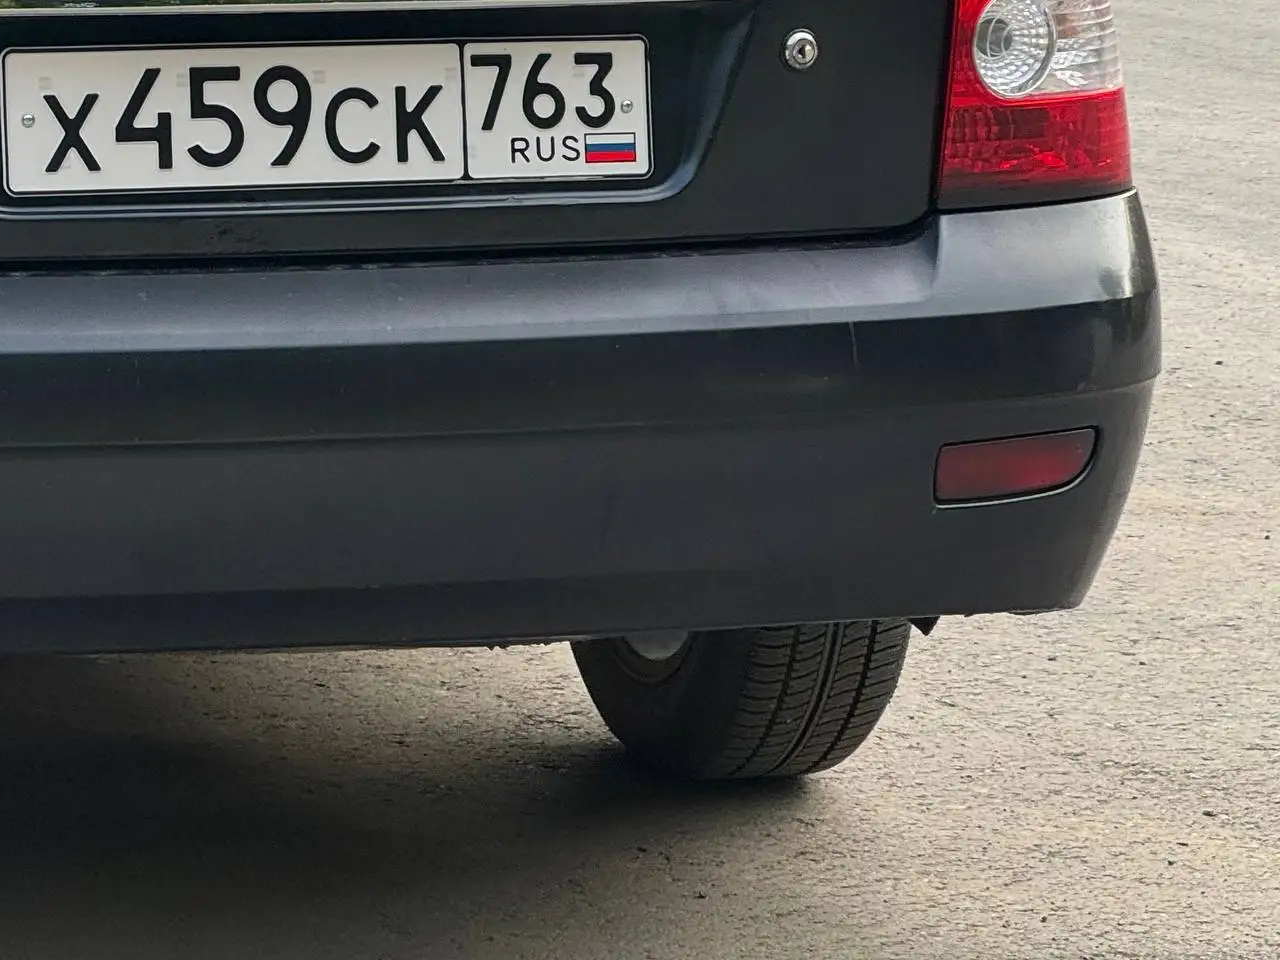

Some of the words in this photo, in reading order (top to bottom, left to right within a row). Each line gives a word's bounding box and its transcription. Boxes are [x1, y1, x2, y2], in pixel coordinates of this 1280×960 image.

[43, 65, 446, 173] Х459СК
[470, 52, 615, 131] 763
[511, 135, 581, 164] RUS
